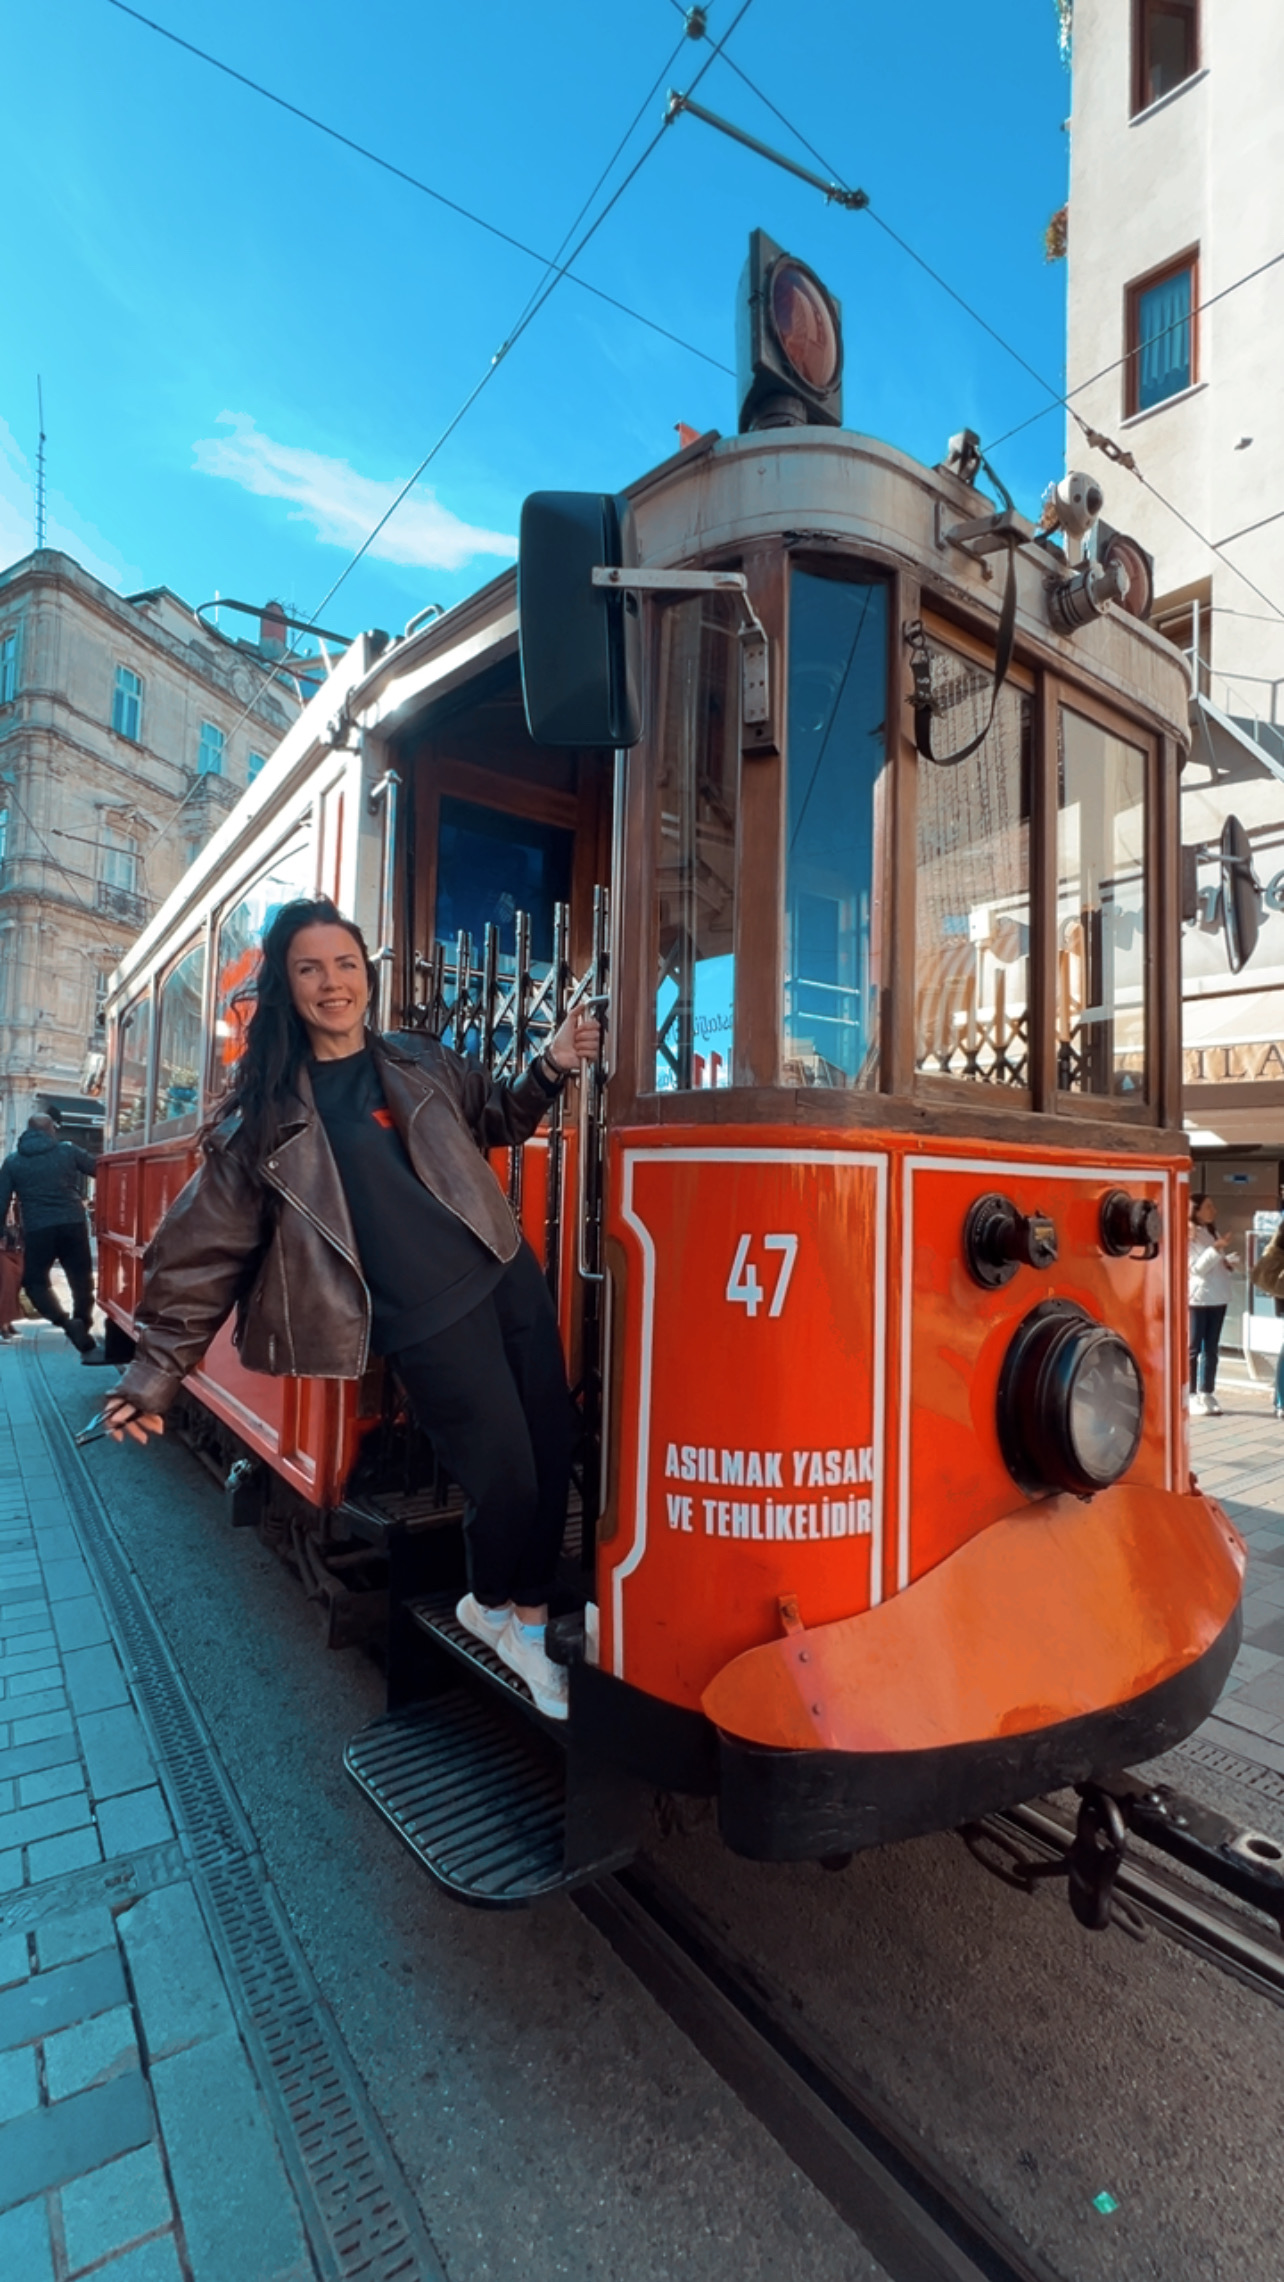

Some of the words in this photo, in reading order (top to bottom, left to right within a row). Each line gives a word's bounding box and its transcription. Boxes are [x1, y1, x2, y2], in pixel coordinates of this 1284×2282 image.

[726, 1233, 798, 1317] 47
[665, 1442, 784, 1488] ASILMAK
[793, 1446, 874, 1488] YASAK
[666, 1493, 693, 1532] VE
[702, 1494, 873, 1540] TEHLİKELİDİR
